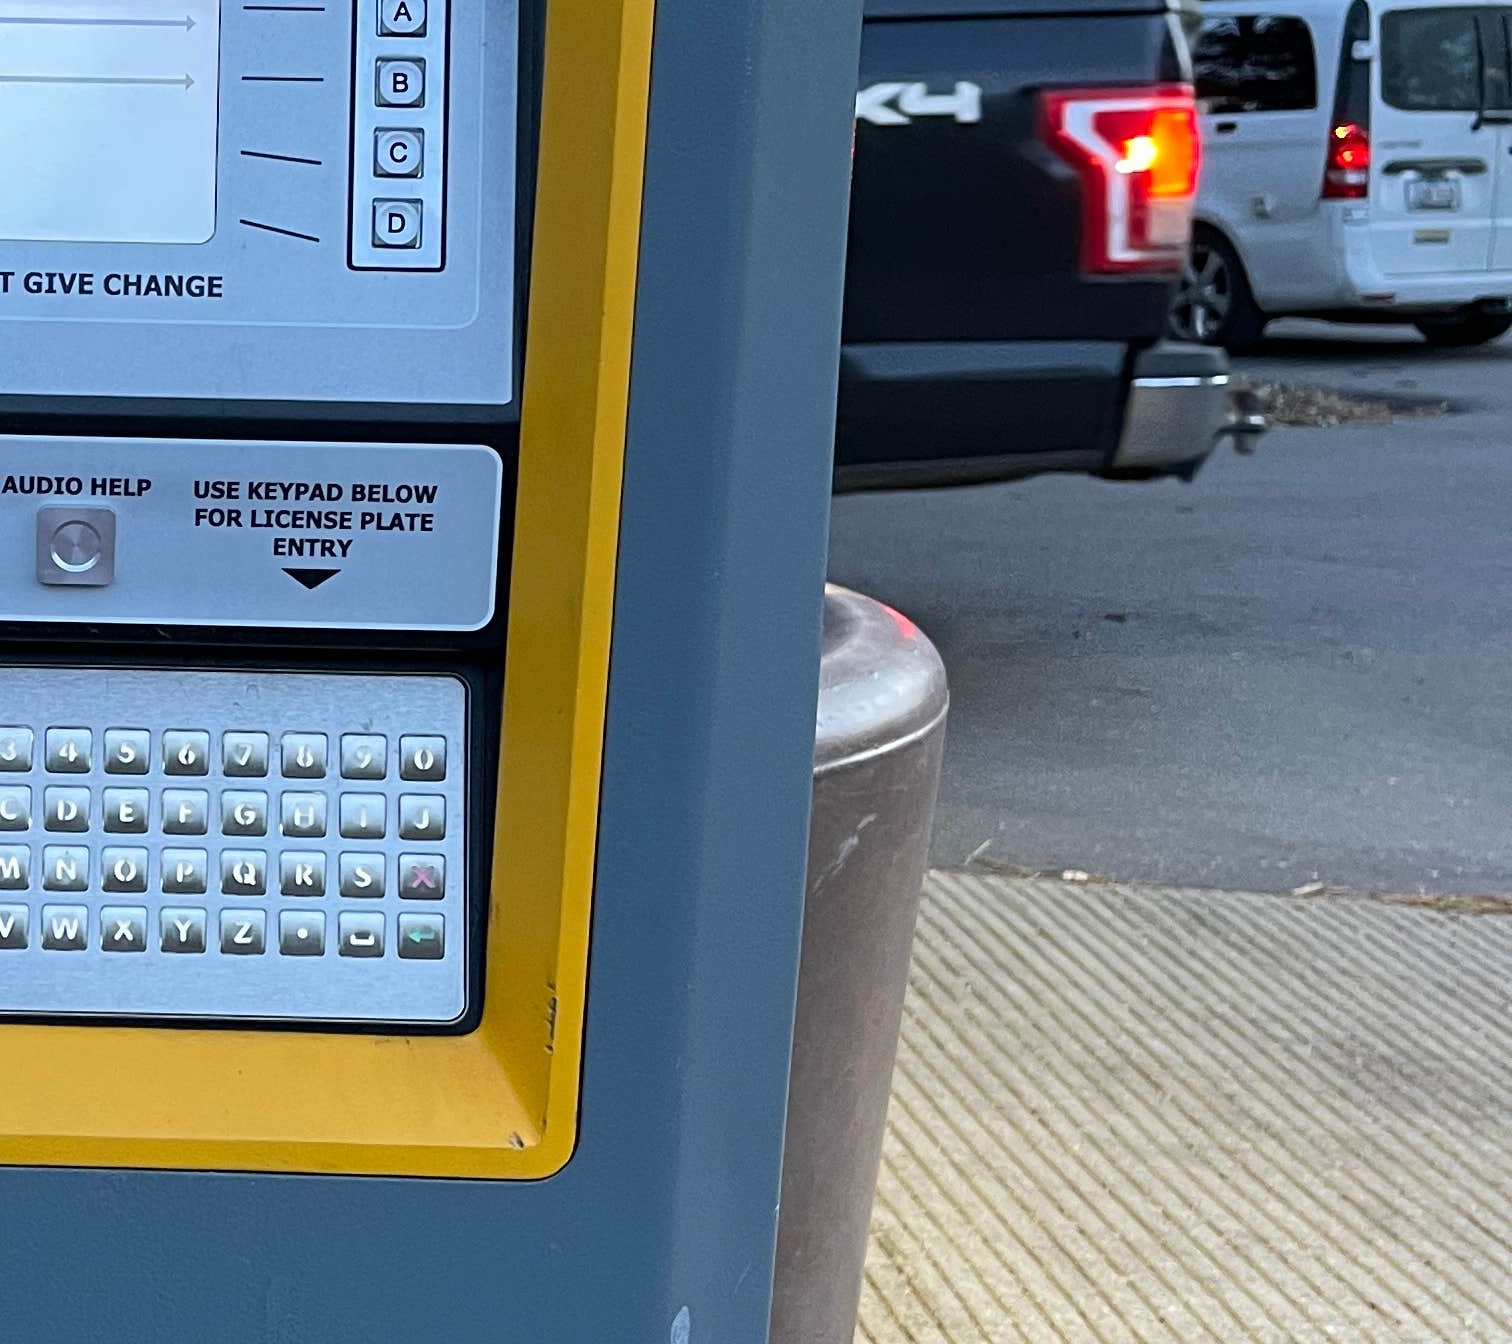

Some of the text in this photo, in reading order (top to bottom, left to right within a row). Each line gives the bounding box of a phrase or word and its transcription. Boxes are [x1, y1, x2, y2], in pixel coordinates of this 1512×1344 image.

[393, 0, 413, 22] A
[392, 72, 409, 94] B
[389, 141, 408, 164] C
[387, 212, 406, 234] D
[23, 271, 94, 295] GIVE
[103, 273, 223, 298] CHANGE
[1, 475, 152, 497] AUDIO HELP
[193, 480, 438, 504] USE KEYPAD BELOW
[194, 507, 435, 532] FOR LICENSE PLATE
[273, 537, 354, 558] ENTRY
[0, 736, 17, 761] 3
[59, 741, 78, 762] 4
[118, 741, 135, 763] 5
[178, 743, 196, 765] 6
[236, 743, 253, 766] 7
[296, 744, 314, 768] 8
[355, 745, 373, 769] 9
[414, 748, 434, 770] 0
[0, 796, 17, 820] C
[57, 799, 77, 821] D
[119, 801, 135, 822] E
[234, 802, 256, 825] G
[413, 807, 430, 830] J
[56, 858, 76, 880] N
[114, 858, 136, 881] O
[176, 861, 194, 883] P
[232, 861, 256, 886] Q
[295, 863, 313, 887] R
[353, 865, 372, 888] S
[51, 917, 79, 940] W
[113, 918, 134, 941] X
[173, 919, 192, 943] Y
[233, 920, 253, 944] Z
